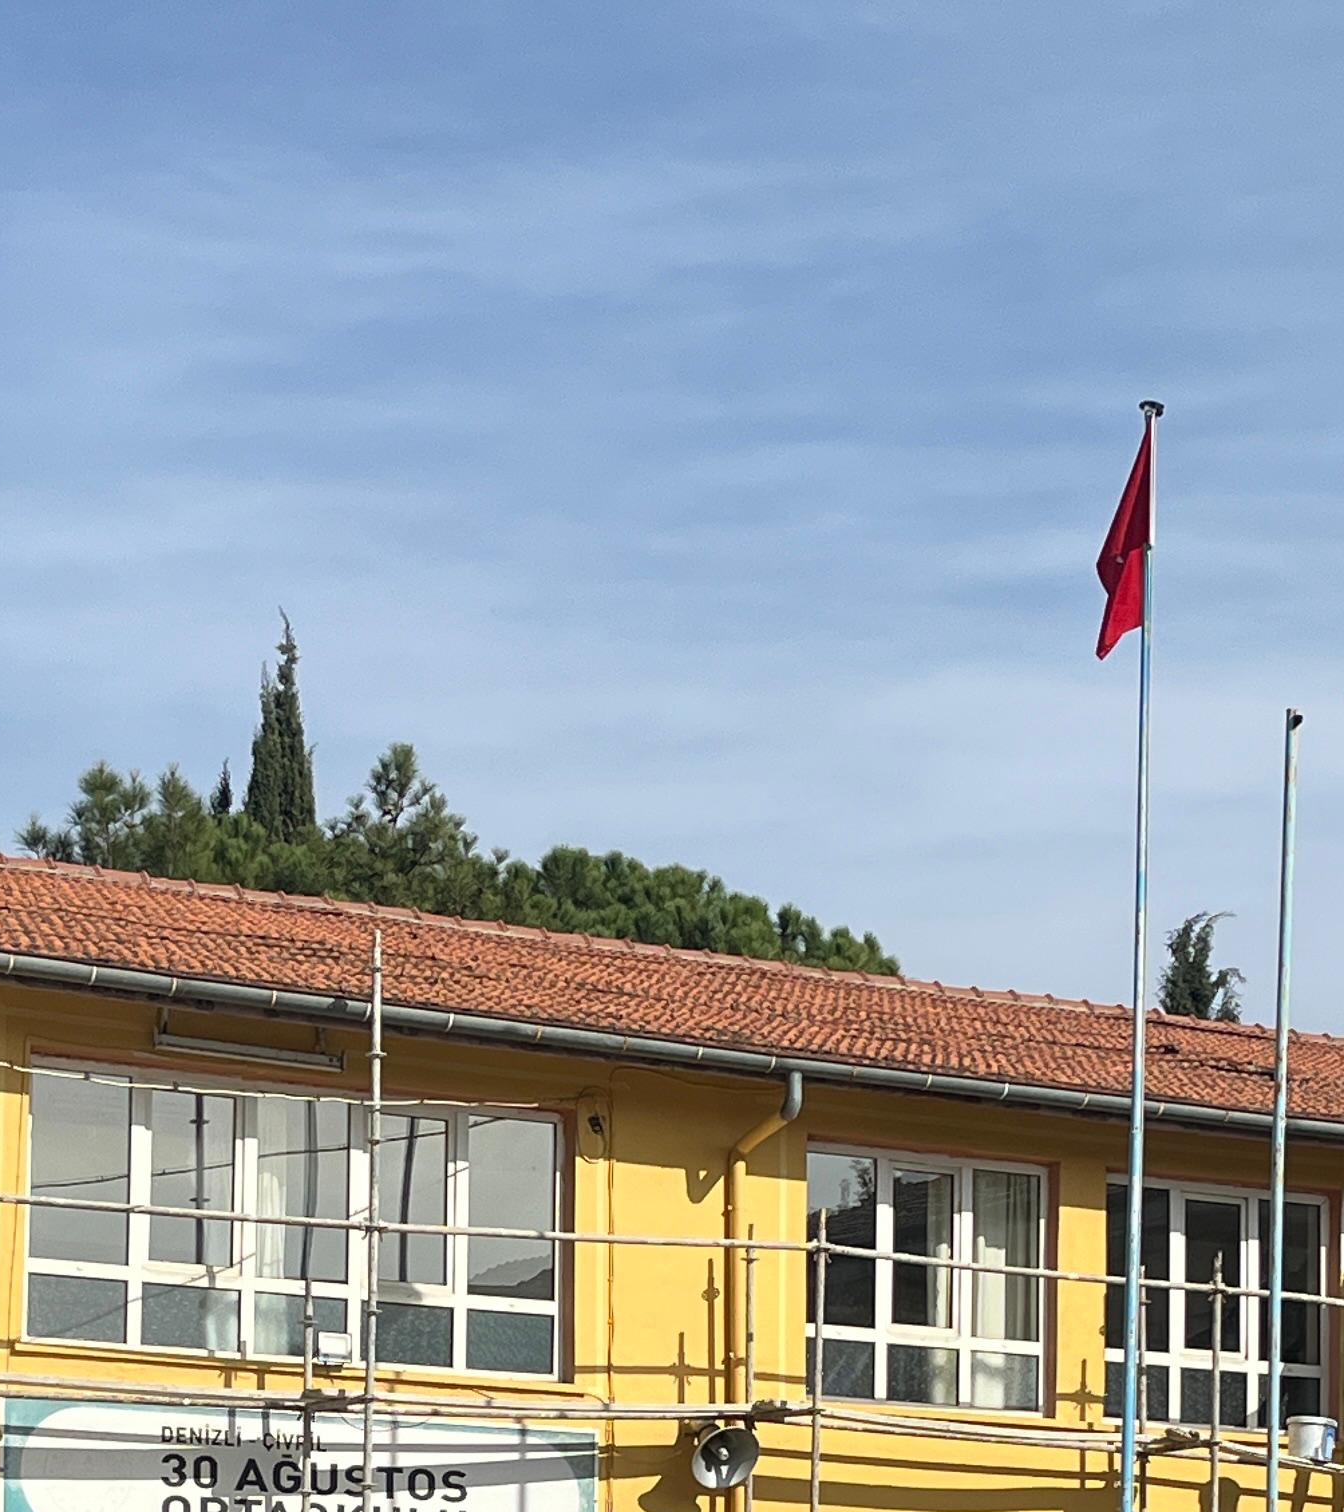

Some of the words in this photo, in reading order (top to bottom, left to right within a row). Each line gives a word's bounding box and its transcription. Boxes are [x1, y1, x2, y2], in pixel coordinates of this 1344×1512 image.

[160, 1423, 243, 1448] DENİZLİ
[262, 1428, 328, 1453] ÇİVRİL
[160, 1453, 219, 1489] 30
[234, 1454, 468, 1503] AĞUSTOS
